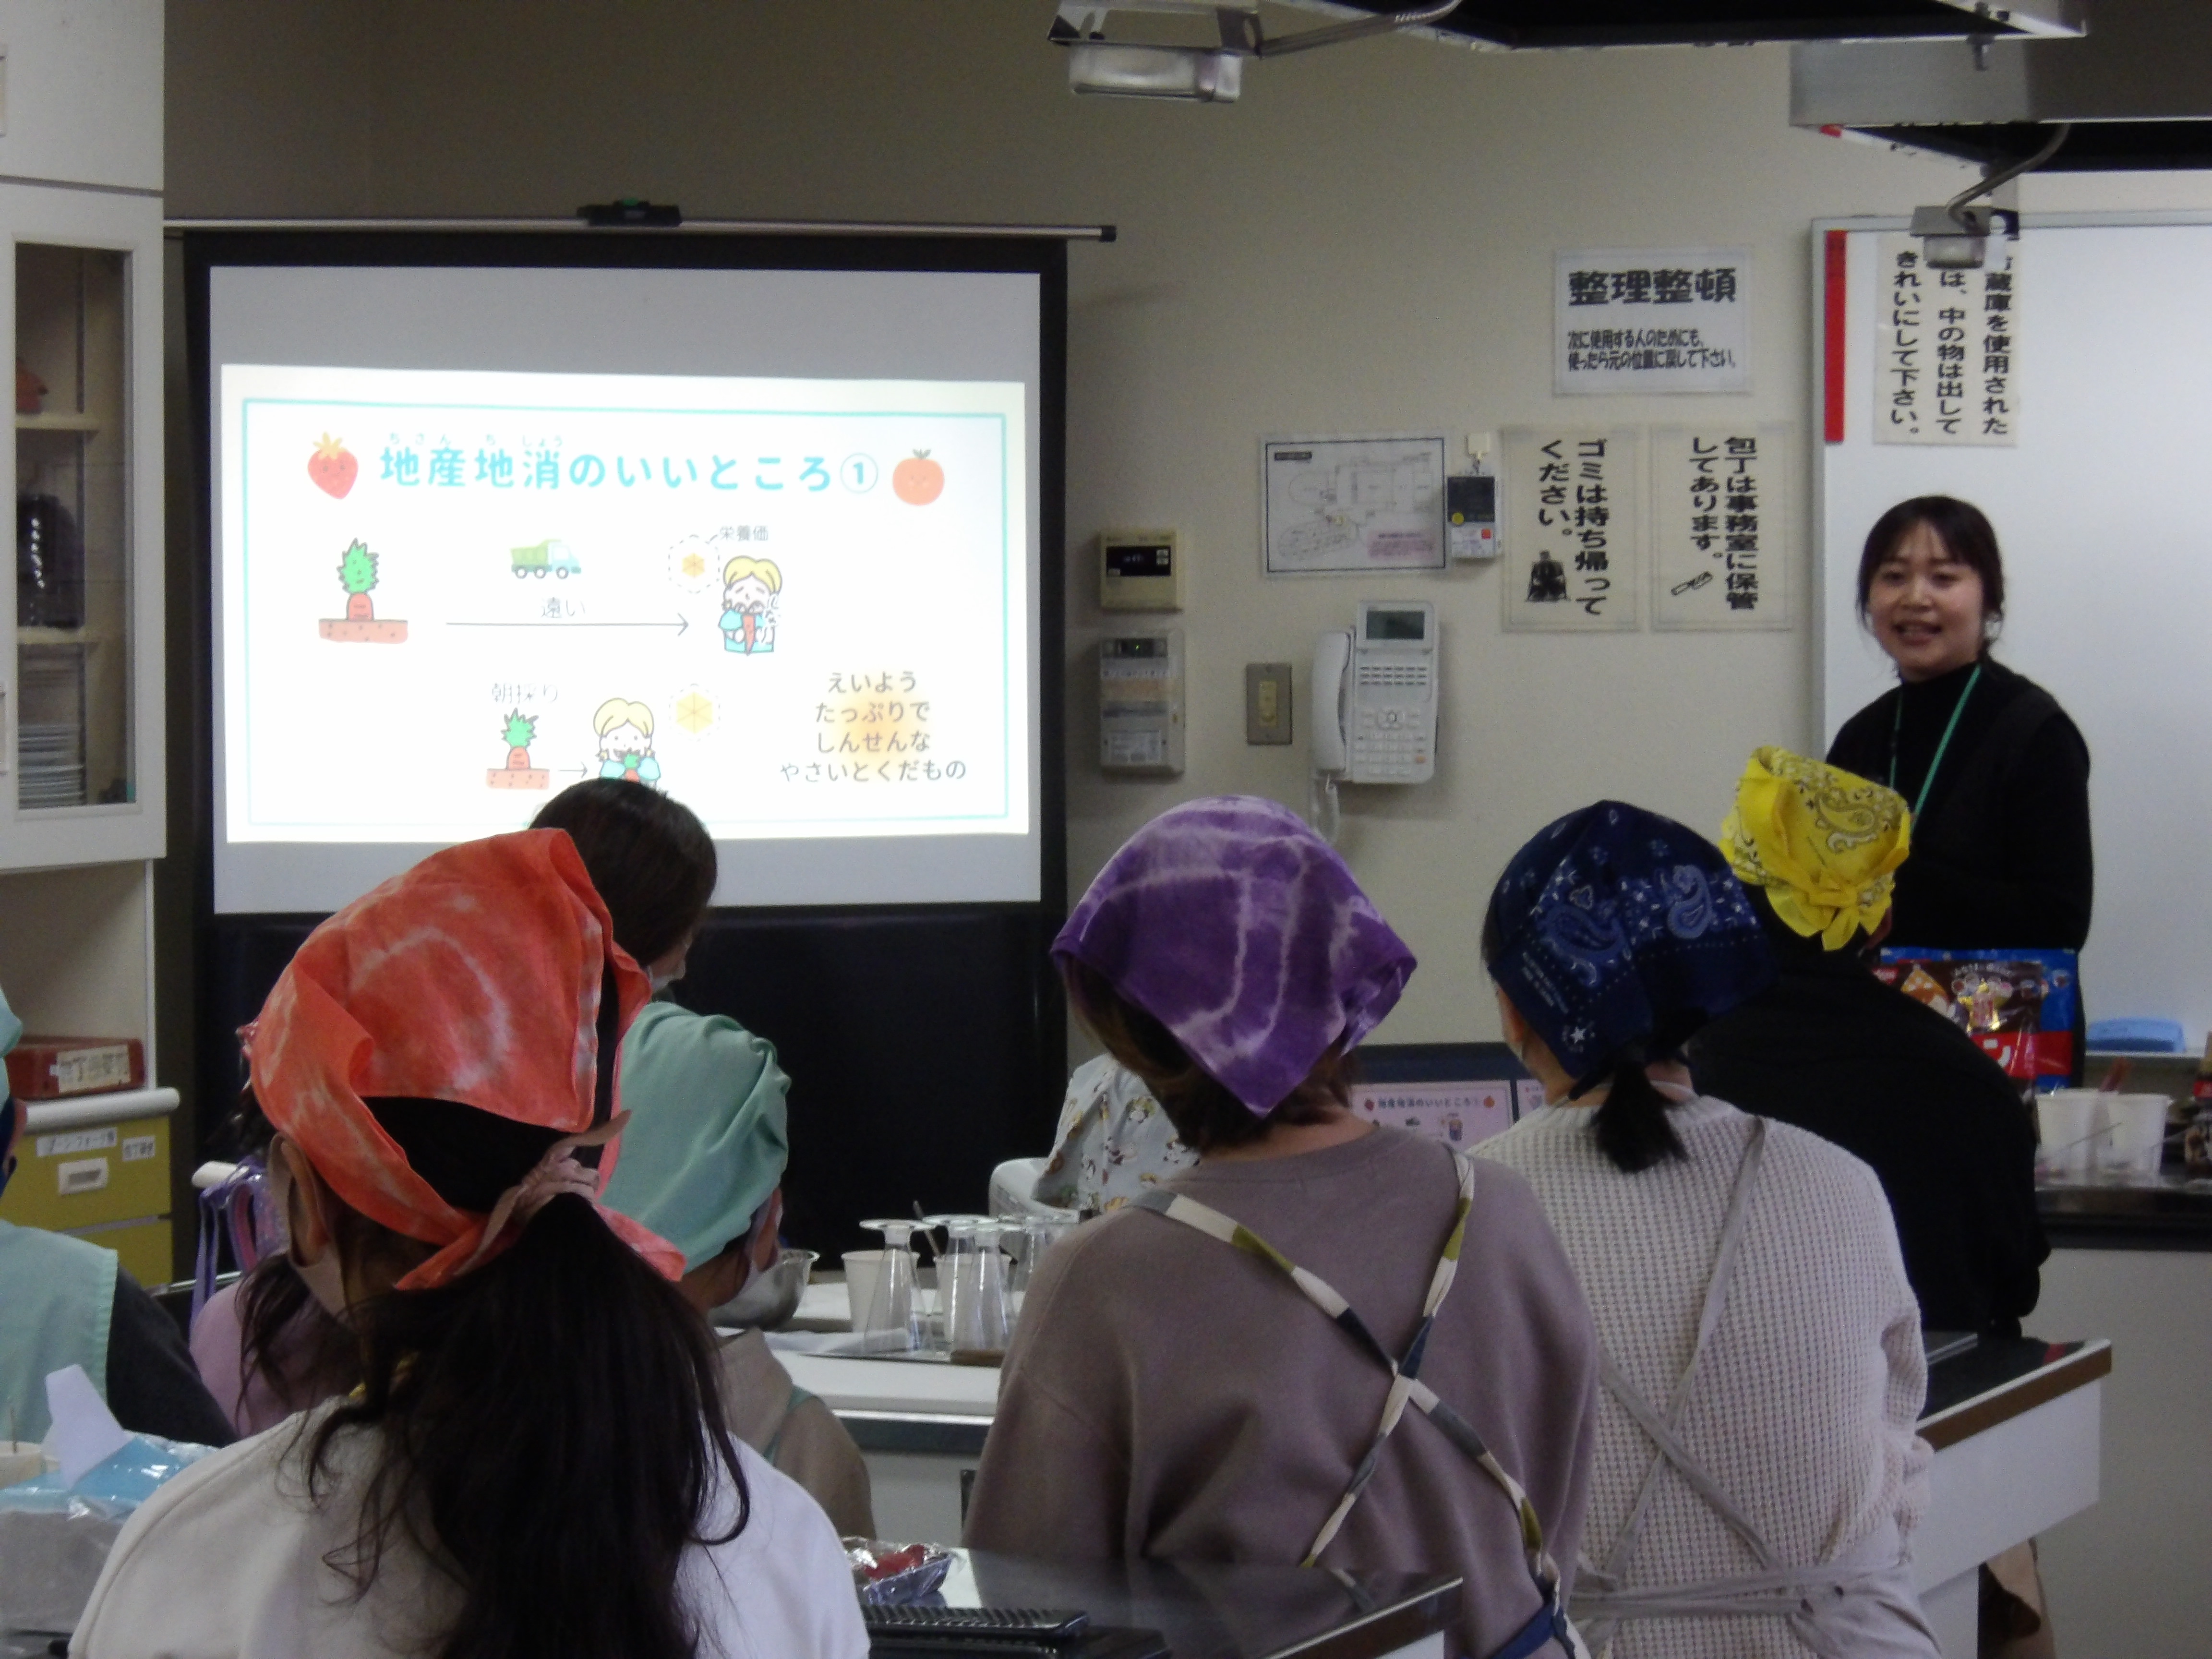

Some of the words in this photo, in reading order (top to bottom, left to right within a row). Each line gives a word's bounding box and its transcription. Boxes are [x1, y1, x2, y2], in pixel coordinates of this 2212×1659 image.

[1568, 267, 1736, 306] 整理整頓
[1889, 250, 1921, 433] きれいにして下さい。
[1936, 271, 1967, 434] は、中の物は出して
[1983, 256, 2013, 434] 蔵庫を使用された
[1539, 439, 1573, 536] ください。
[1689, 436, 1723, 559] してあります。
[719, 525, 769, 542] 栄養価
[1574, 438, 1611, 615] ゴミは持ち帰って
[541, 597, 586, 619] 遠い
[491, 682, 558, 704] 朝採り
[828, 670, 917, 694] えいよう
[816, 700, 930, 723] たっぷりで
[818, 729, 930, 754] しんせんな
[779, 758, 966, 782] やさいとくだもの
